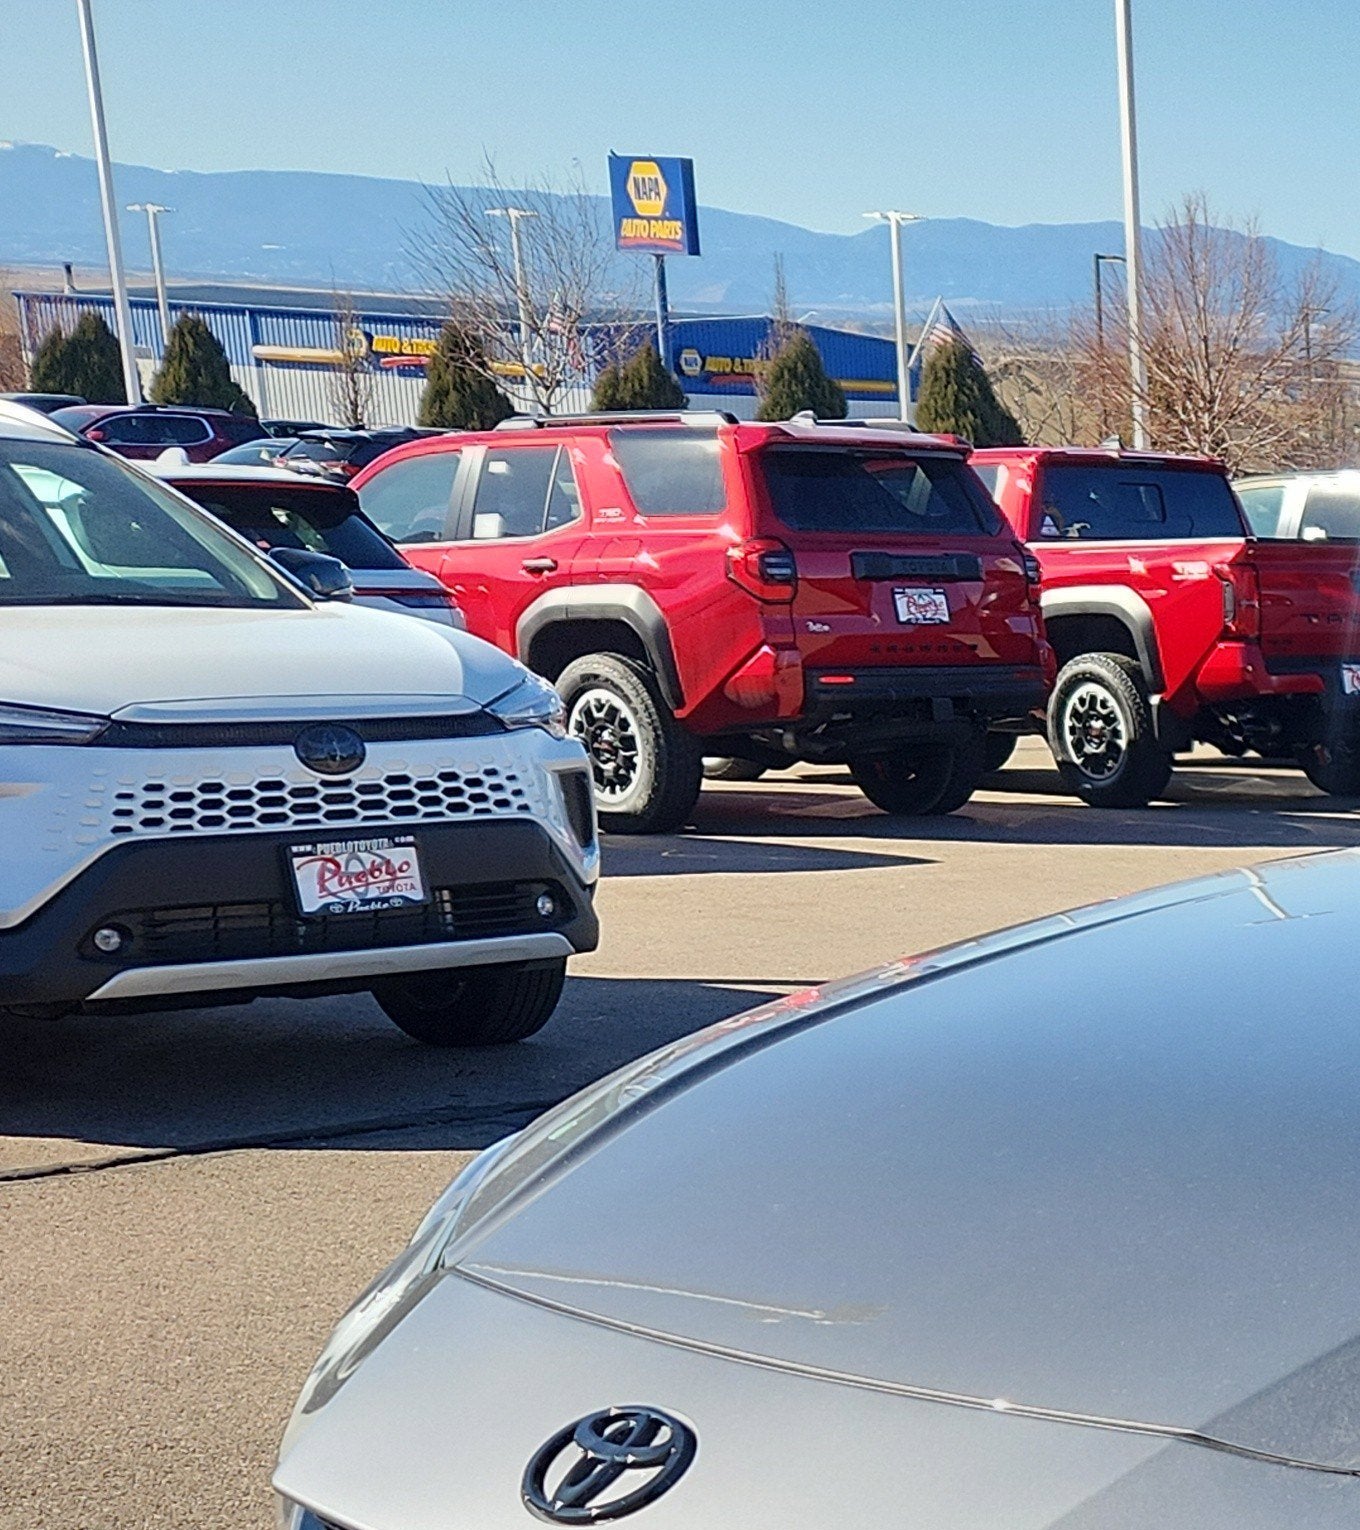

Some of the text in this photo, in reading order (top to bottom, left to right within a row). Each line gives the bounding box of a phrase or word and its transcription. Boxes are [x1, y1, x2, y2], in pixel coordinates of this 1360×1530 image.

[633, 176, 661, 202] NAPA
[621, 218, 682, 240] AUTO PARTS
[372, 335, 400, 353] AUTO
